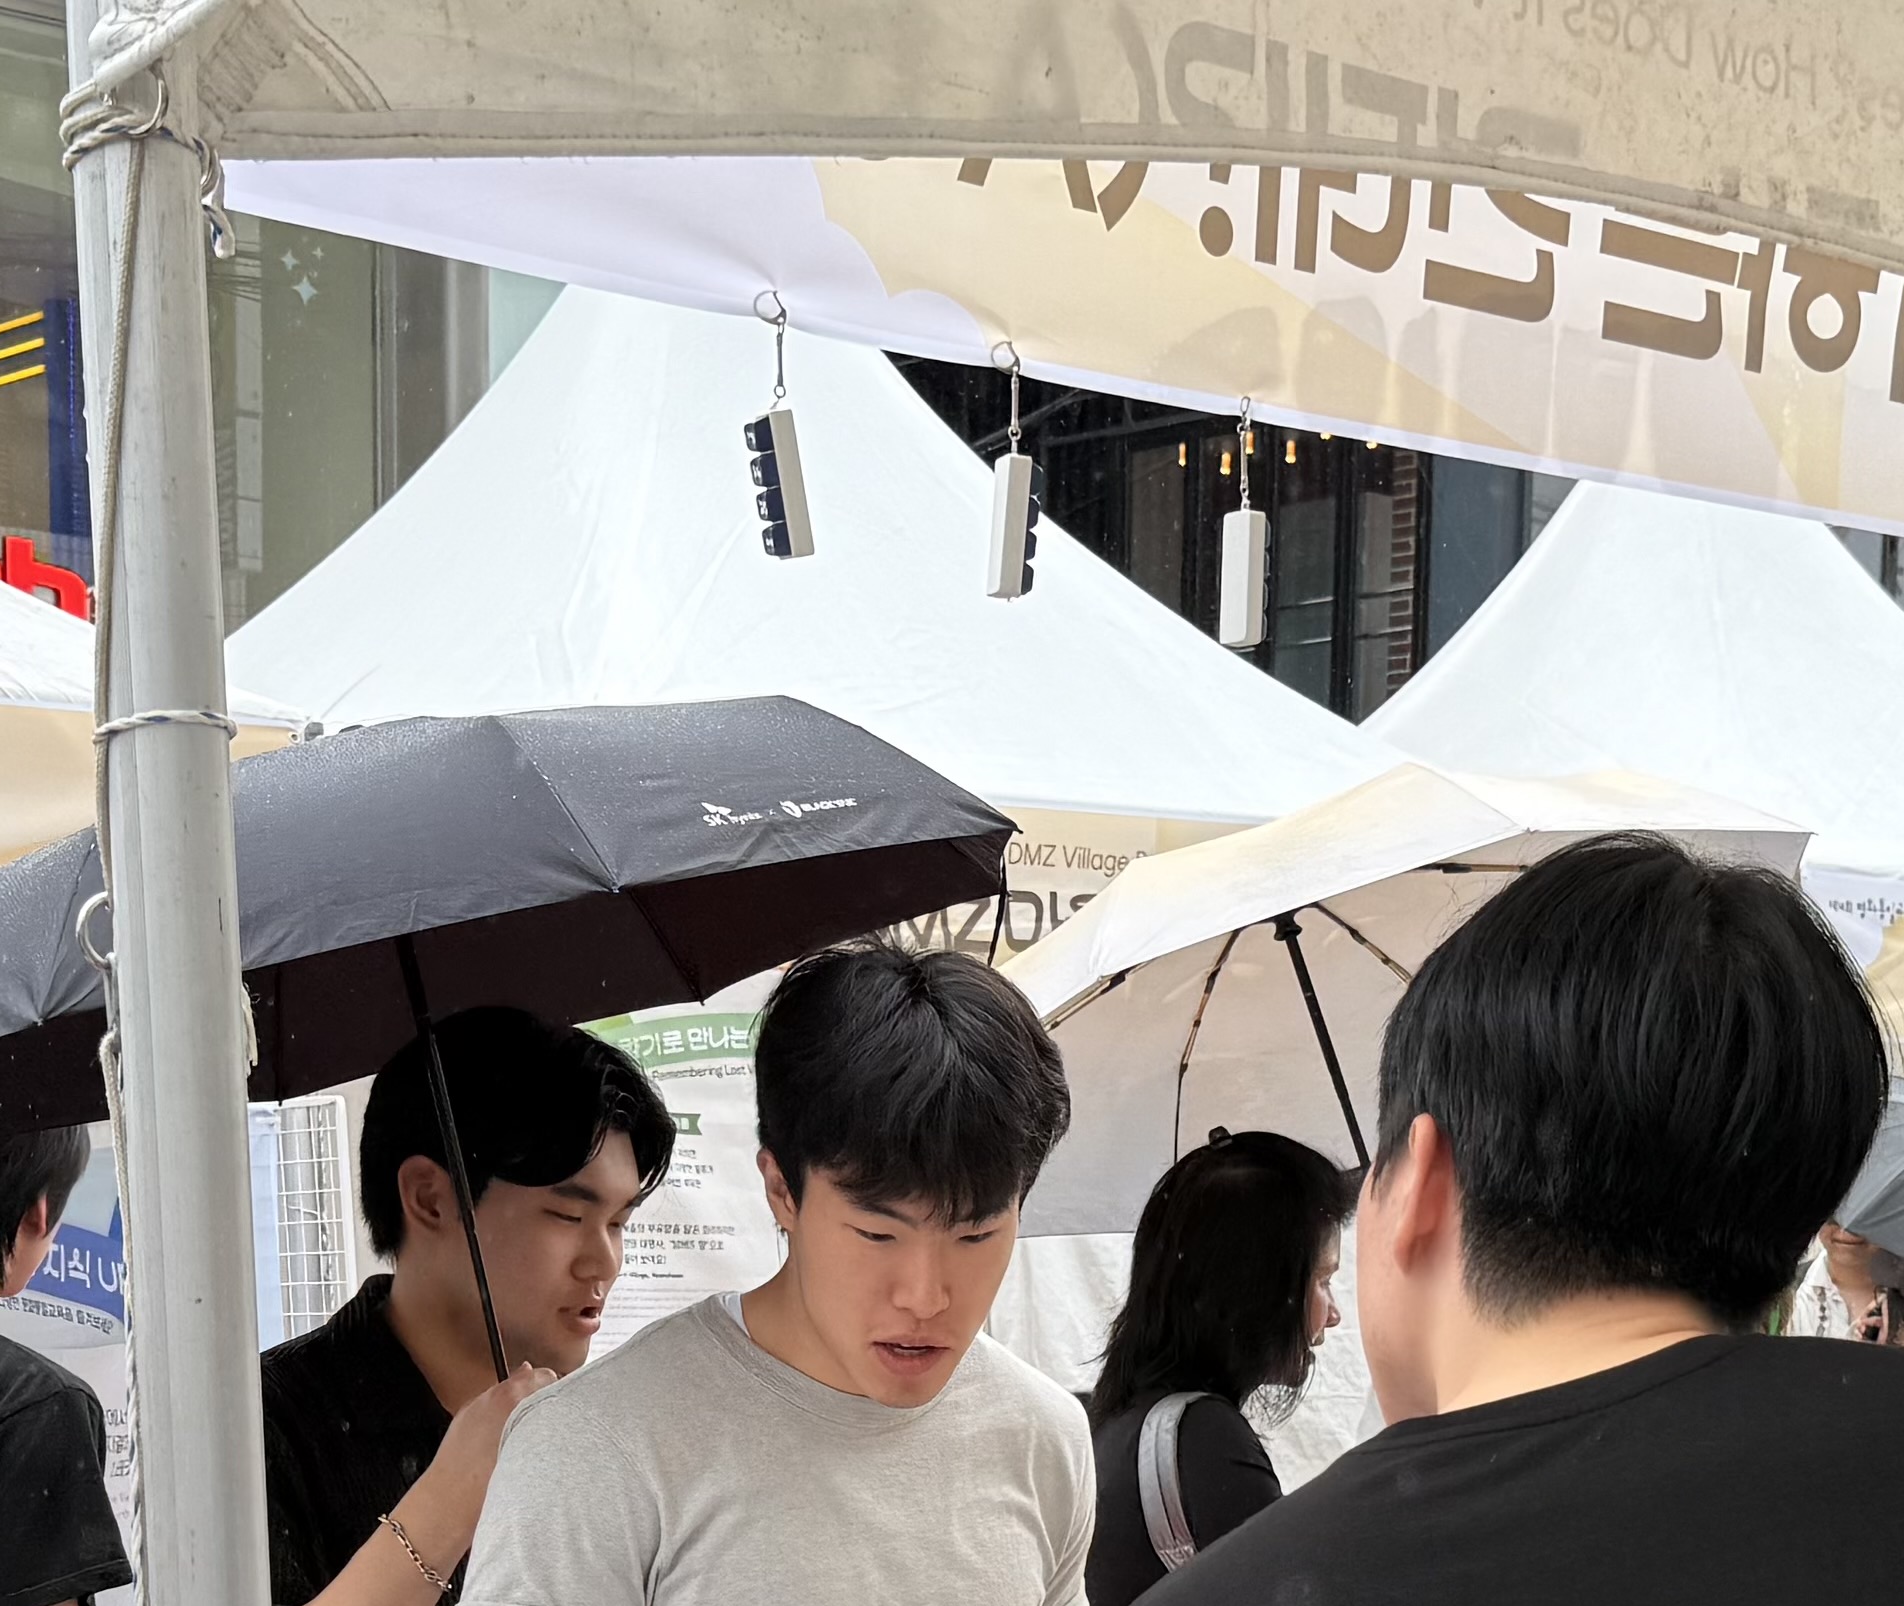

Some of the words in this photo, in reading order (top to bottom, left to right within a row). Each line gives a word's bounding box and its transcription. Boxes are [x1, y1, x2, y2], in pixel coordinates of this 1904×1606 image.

[1008, 842, 1057, 867] DMZ
[1062, 845, 1130, 878] Village
[687, 1026, 750, 1051] 만나는
[42, 1242, 91, 1289] 지식
